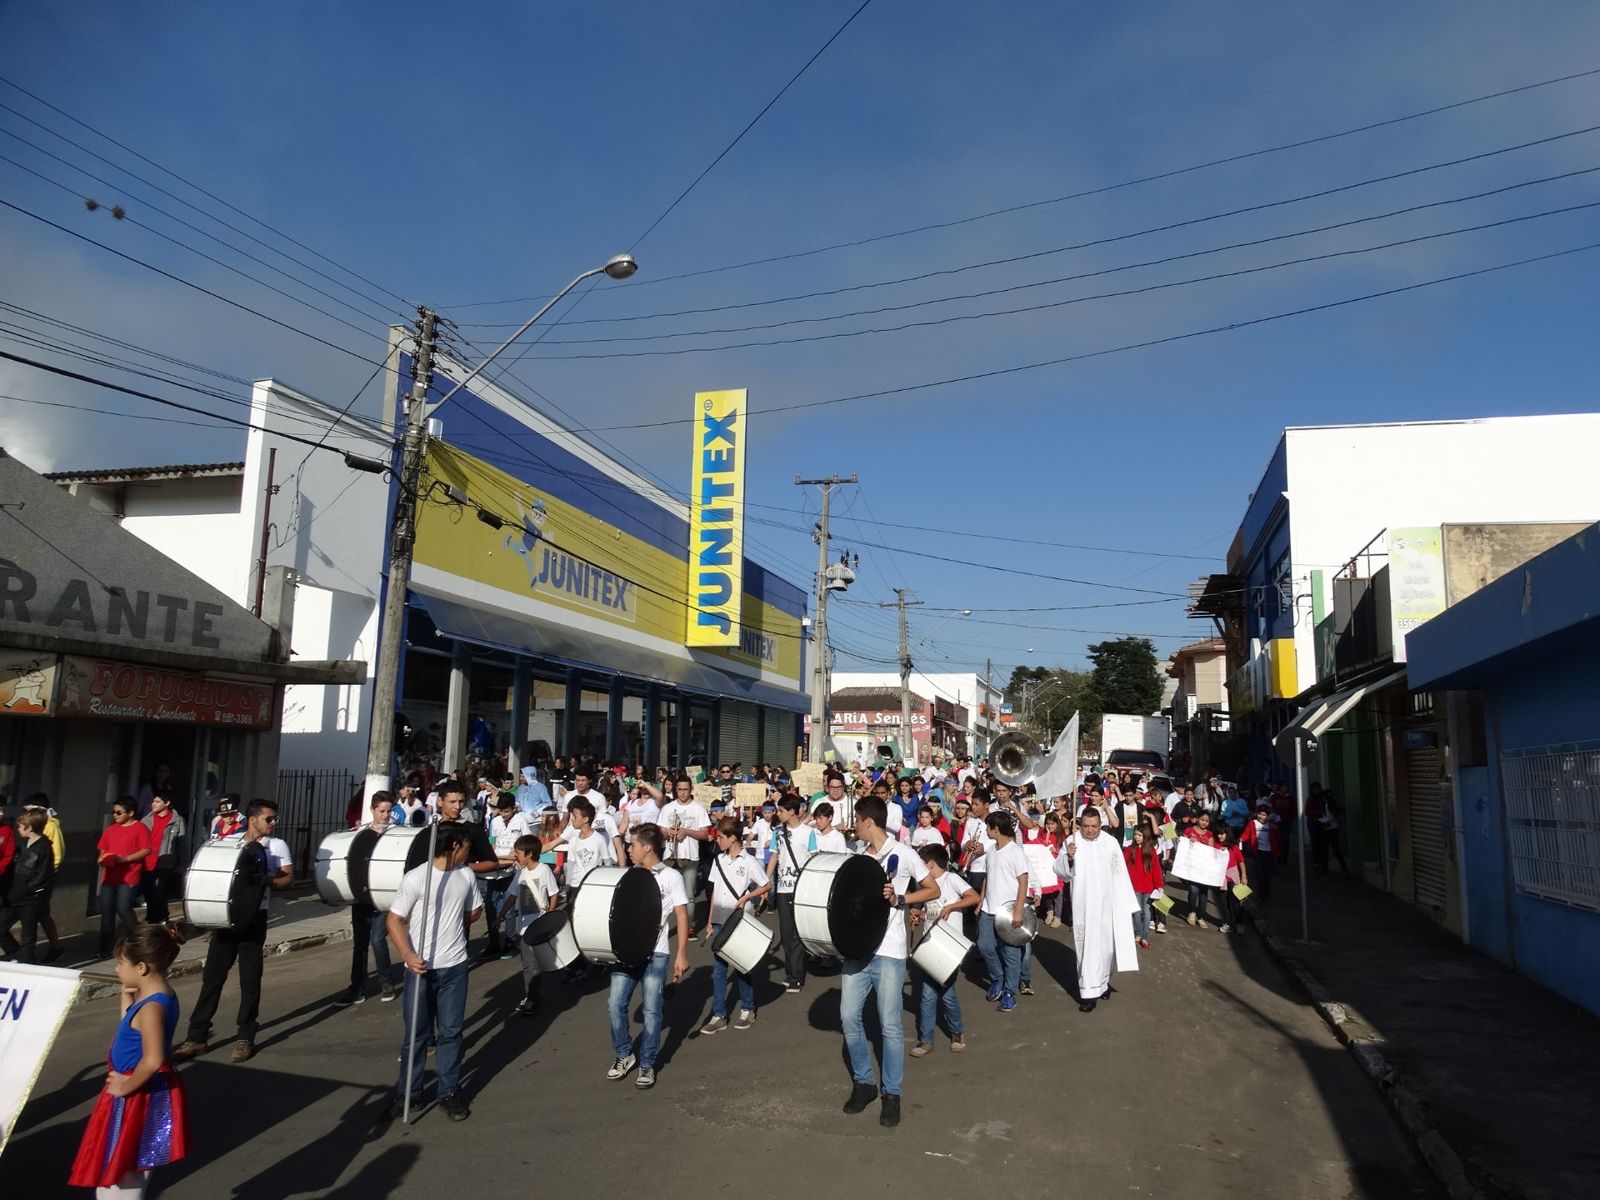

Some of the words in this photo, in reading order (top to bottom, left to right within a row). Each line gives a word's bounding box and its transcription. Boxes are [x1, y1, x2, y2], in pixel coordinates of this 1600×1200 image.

[0, 566, 224, 649] RANTE
[539, 548, 628, 612] JUNITEX
[88, 697, 145, 719] Restaurante
[152, 704, 197, 720] Lanchonete
[90, 661, 256, 710] FOFUCHO'S
